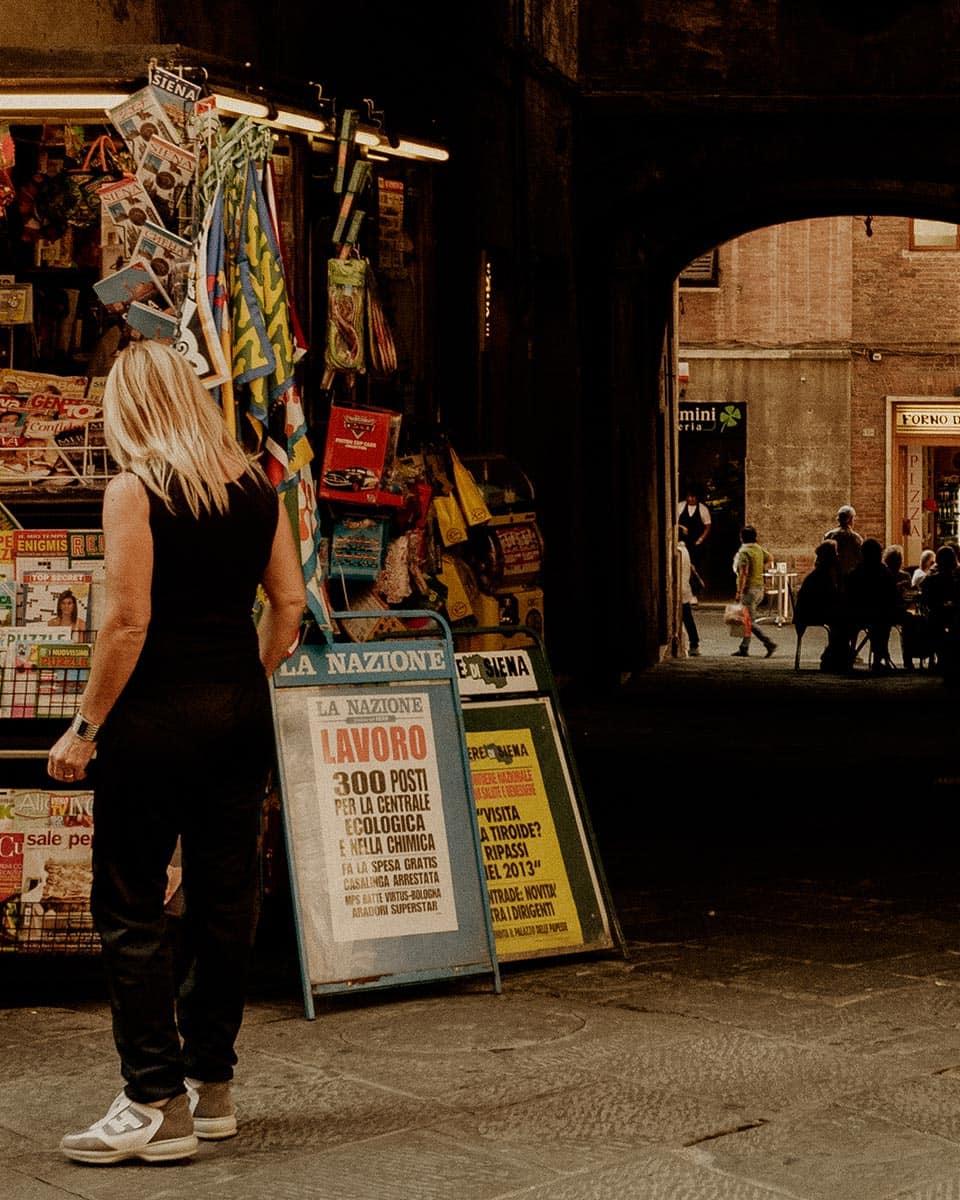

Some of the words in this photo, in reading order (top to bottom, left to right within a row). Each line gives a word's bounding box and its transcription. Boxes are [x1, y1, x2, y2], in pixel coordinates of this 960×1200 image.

[151, 73, 196, 101] SIENA
[680, 407, 716, 422] mini
[902, 414, 948, 426] FORNO
[910, 455, 921, 538] PIZZA
[17, 540, 68, 552] ENIGMIS
[279, 654, 317, 677] LA
[326, 649, 446, 676] NAZIONE
[483, 655, 530, 678] SIENA
[316, 700, 340, 717] LA
[347, 696, 424, 716] NAZIONE
[320, 724, 428, 765] LAVORO
[332, 769, 387, 796] 300
[389, 767, 429, 793] POSTI
[334, 797, 357, 816] PER
[359, 796, 374, 815] LA
[376, 793, 431, 814] CENTRALE
[345, 813, 426, 837] ECOLOGICA
[490, 821, 542, 841] TIROIDE?
[27, 831, 62, 846] sale
[339, 839, 347, 858] E
[350, 837, 384, 856] NELLA
[386, 833, 437, 854] CHIMICA
[484, 841, 529, 861] RIPASSI
[371, 859, 402, 873] SPESA
[404, 856, 439, 871] GRATIS
[344, 875, 391, 891] CASALINGA
[393, 871, 440, 887] ARRESTATA
[345, 894, 361, 906] MPS
[524, 882, 557, 902] NOVITA'
[352, 905, 389, 919] ARADORI
[390, 901, 438, 915] SUPERSTAR
[511, 901, 556, 921] DIRIGENTI
